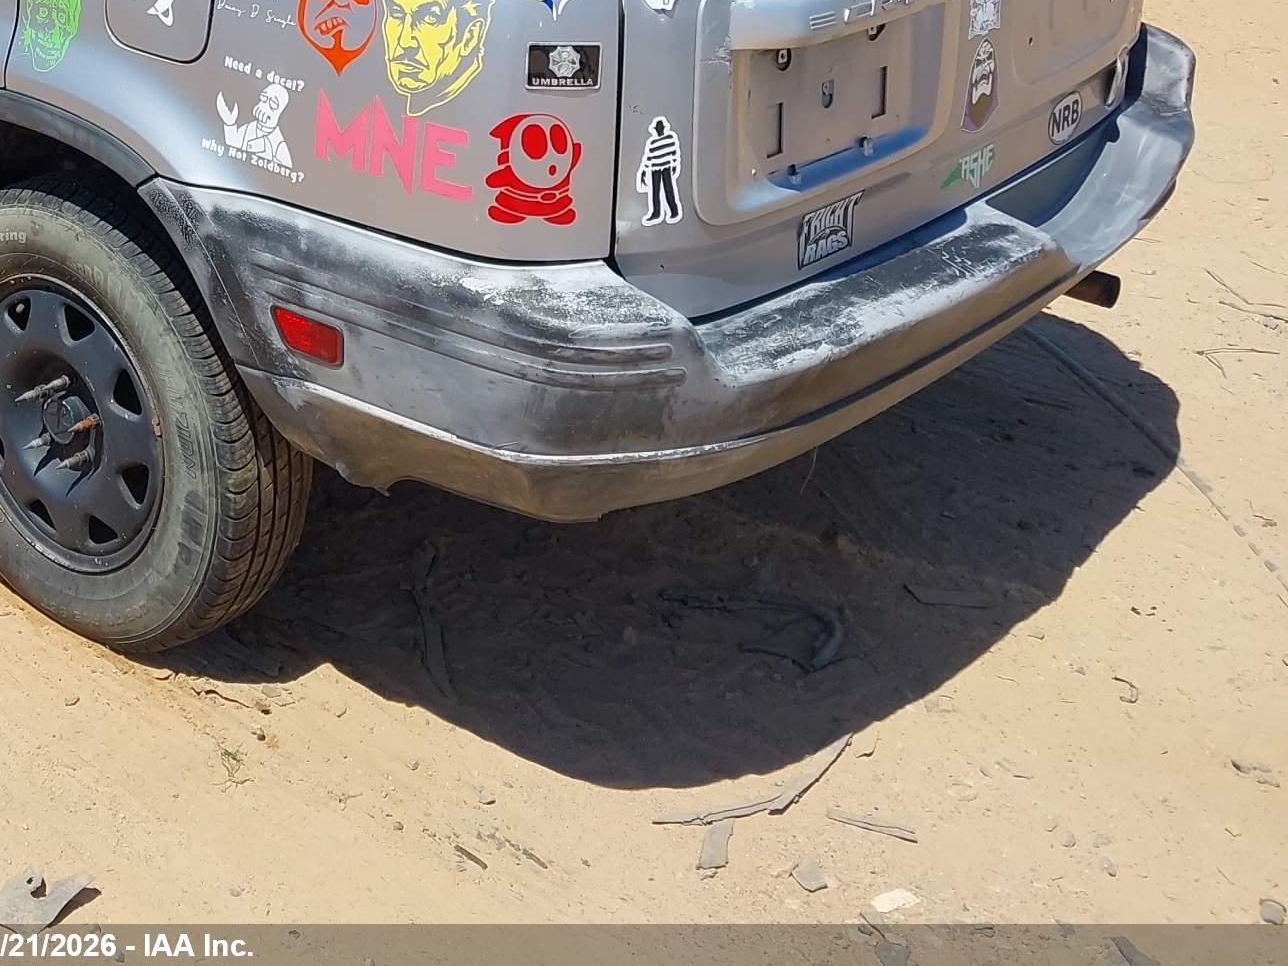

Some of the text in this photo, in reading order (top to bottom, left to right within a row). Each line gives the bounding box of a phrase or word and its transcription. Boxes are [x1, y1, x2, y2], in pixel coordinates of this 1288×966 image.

[224, 55, 305, 92] Need a decal?
[532, 77, 594, 86] UMBRELLA
[1050, 99, 1080, 137] NRB
[315, 88, 473, 203] MNE
[228, 146, 247, 163] Not
[250, 154, 305, 184] Zoidberg?
[802, 230, 850, 265] RAGS
